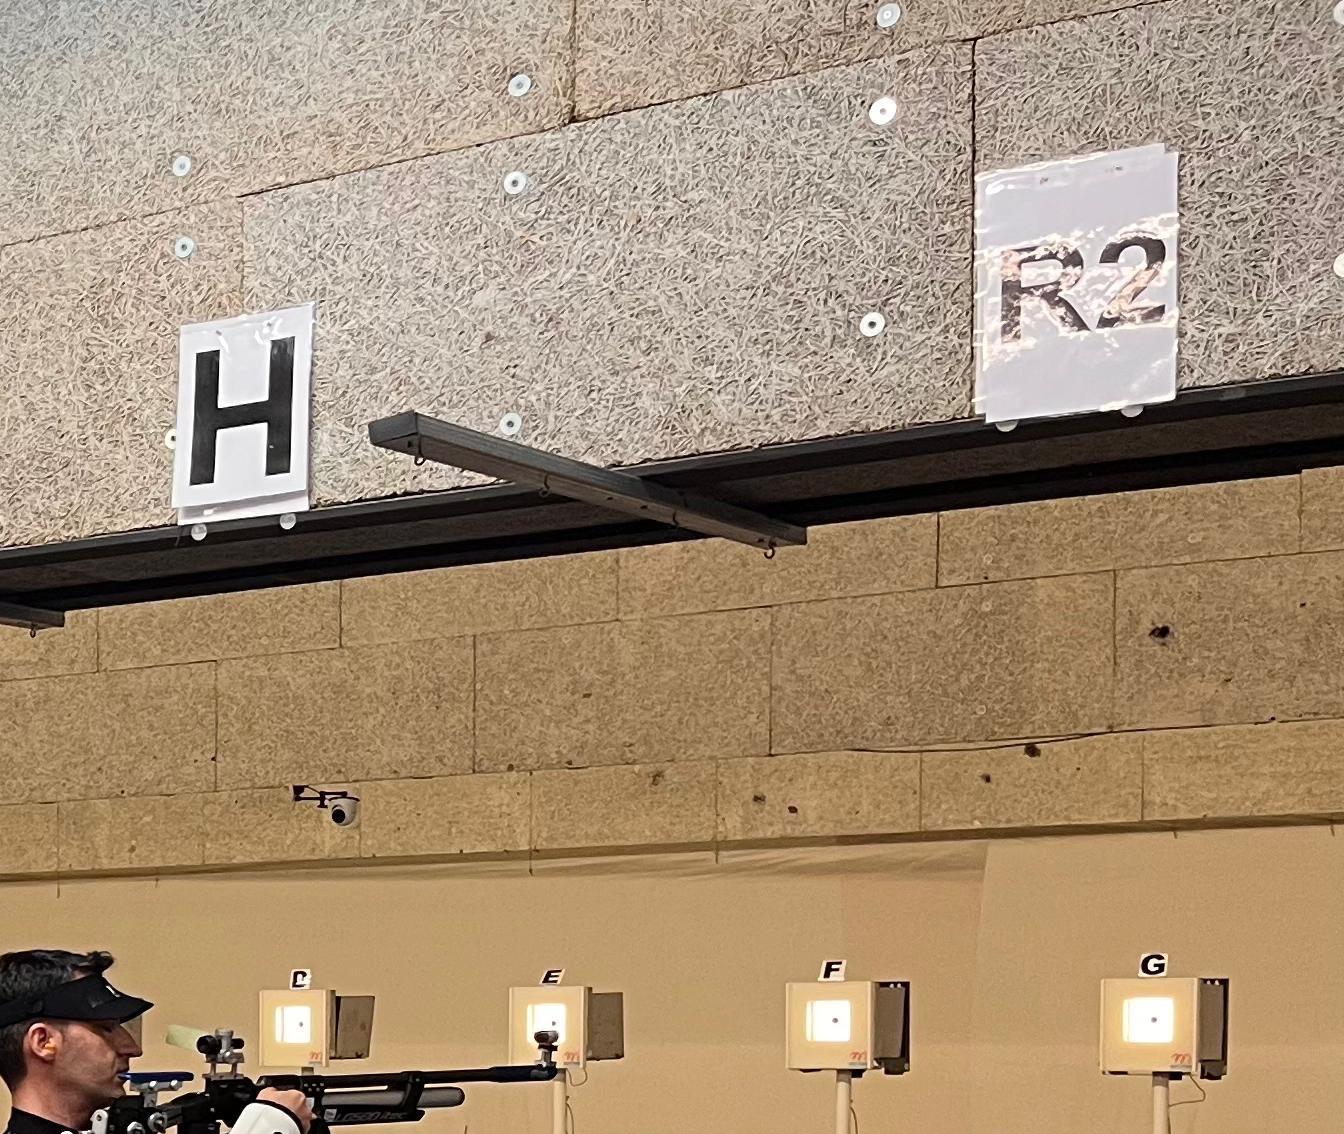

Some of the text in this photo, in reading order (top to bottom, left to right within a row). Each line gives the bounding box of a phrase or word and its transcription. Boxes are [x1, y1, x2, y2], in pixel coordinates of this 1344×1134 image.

[1002, 231, 1166, 344] R2
[189, 336, 295, 486] H
[823, 960, 843, 979] F
[1140, 953, 1166, 976] G
[541, 969, 563, 984] E
